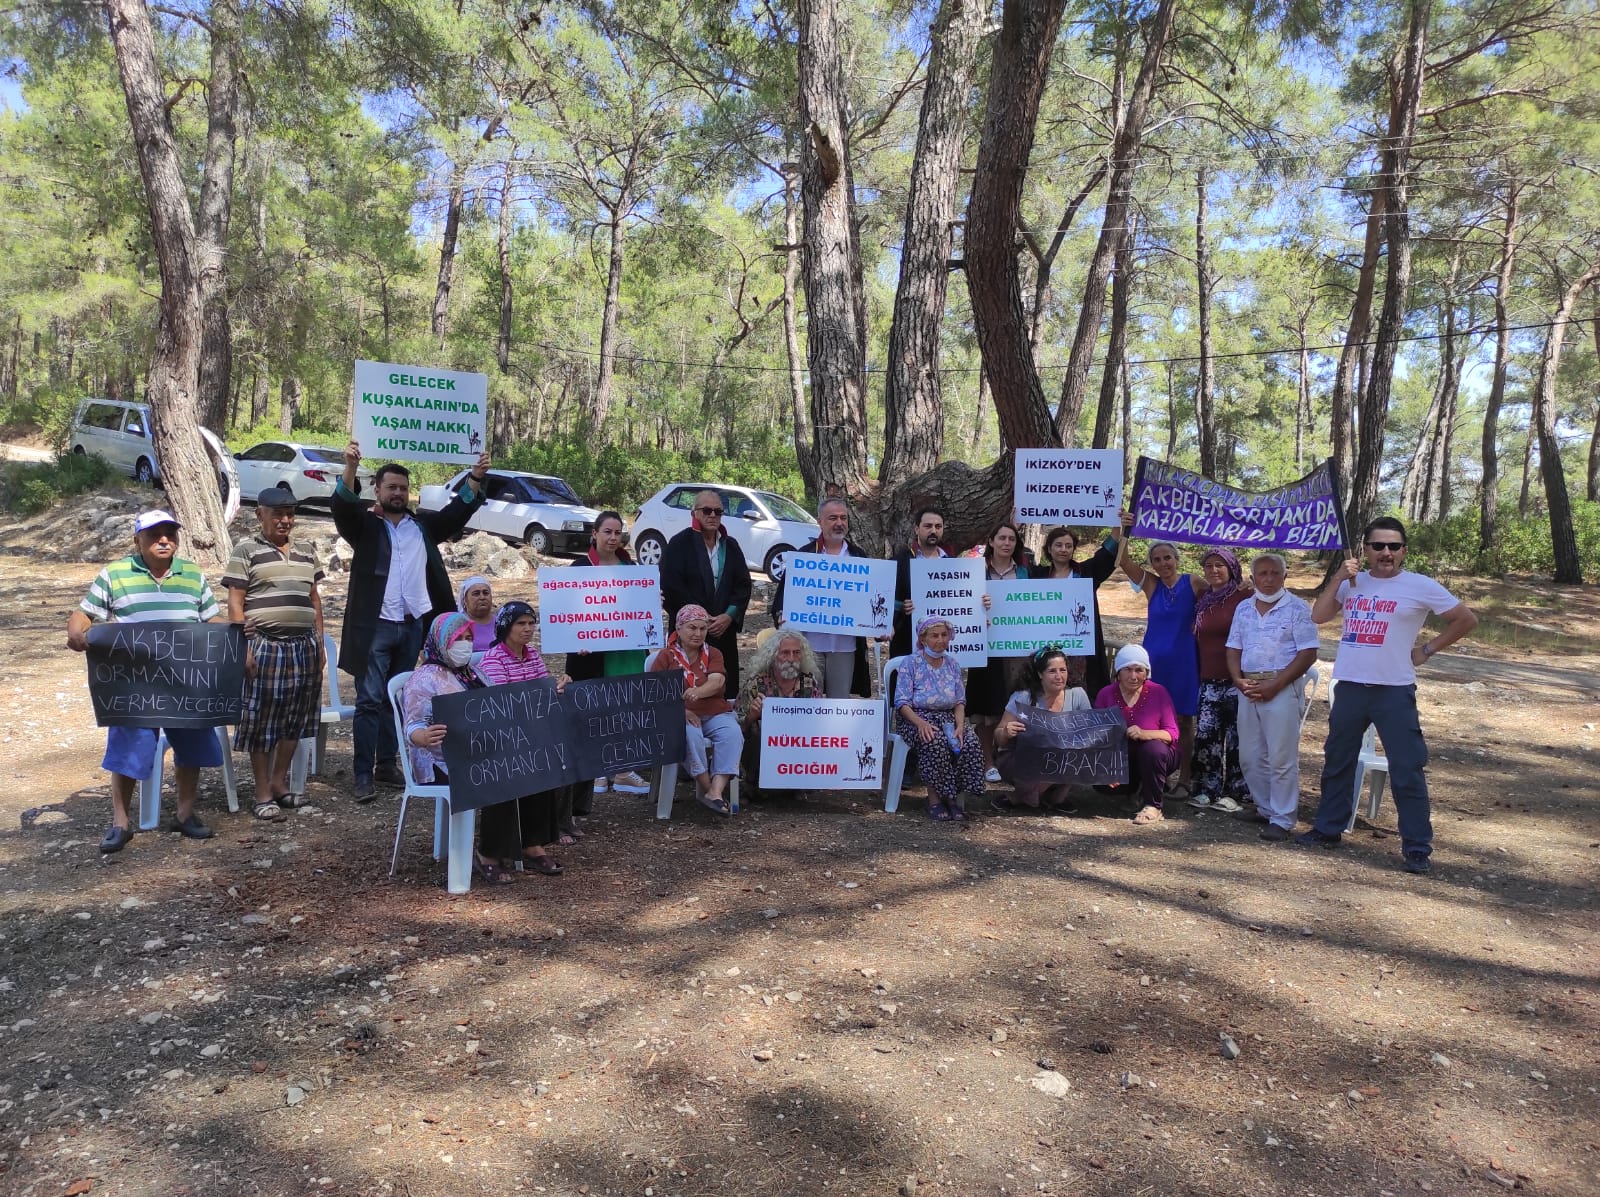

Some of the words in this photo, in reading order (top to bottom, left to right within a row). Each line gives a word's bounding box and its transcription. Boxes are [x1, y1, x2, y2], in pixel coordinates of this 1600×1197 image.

[389, 374, 456, 391] GELECEK
[371, 416, 422, 431] YAŞAM
[426, 421, 471, 434] HAKKI
[1140, 485, 1225, 519] AKBELEN
[1020, 508, 1060, 517] SELAM
[1063, 509, 1104, 519] OLSUN
[1283, 521, 1343, 547] BİZİM
[794, 559, 870, 575] DOĞANIN
[927, 571, 970, 581] YAŞASIN
[792, 576, 869, 592] MALİYETİ
[585, 595, 617, 604] OLAN
[806, 595, 842, 607] SIFIR
[926, 589, 973, 599] AKBELEN
[1005, 591, 1063, 601] AKBELEN
[1356, 598, 1372, 611] WILL
[1375, 600, 1397, 613] NEVER
[549, 611, 653, 625] DÜŞMANLIĞINIZA
[790, 612, 854, 627] DEĞİLDİR
[992, 615, 1068, 626] ORMANLARINI
[1349, 619, 1389, 634] FORGOTTEN
[109, 628, 239, 665] AKBELEN
[96, 663, 218, 689] ORMANINI
[574, 678, 684, 711] ORMANIMIZDAN
[464, 688, 562, 723] CANIMIZA
[836, 707, 848, 715] bu
[851, 708, 875, 717] yana
[470, 726, 530, 755] KIYMA
[768, 734, 849, 748] NÜKLEERE
[1057, 728, 1111, 747] RAHAT
[470, 748, 551, 786] ORMANCI
[777, 762, 838, 775] GICIĞIM
